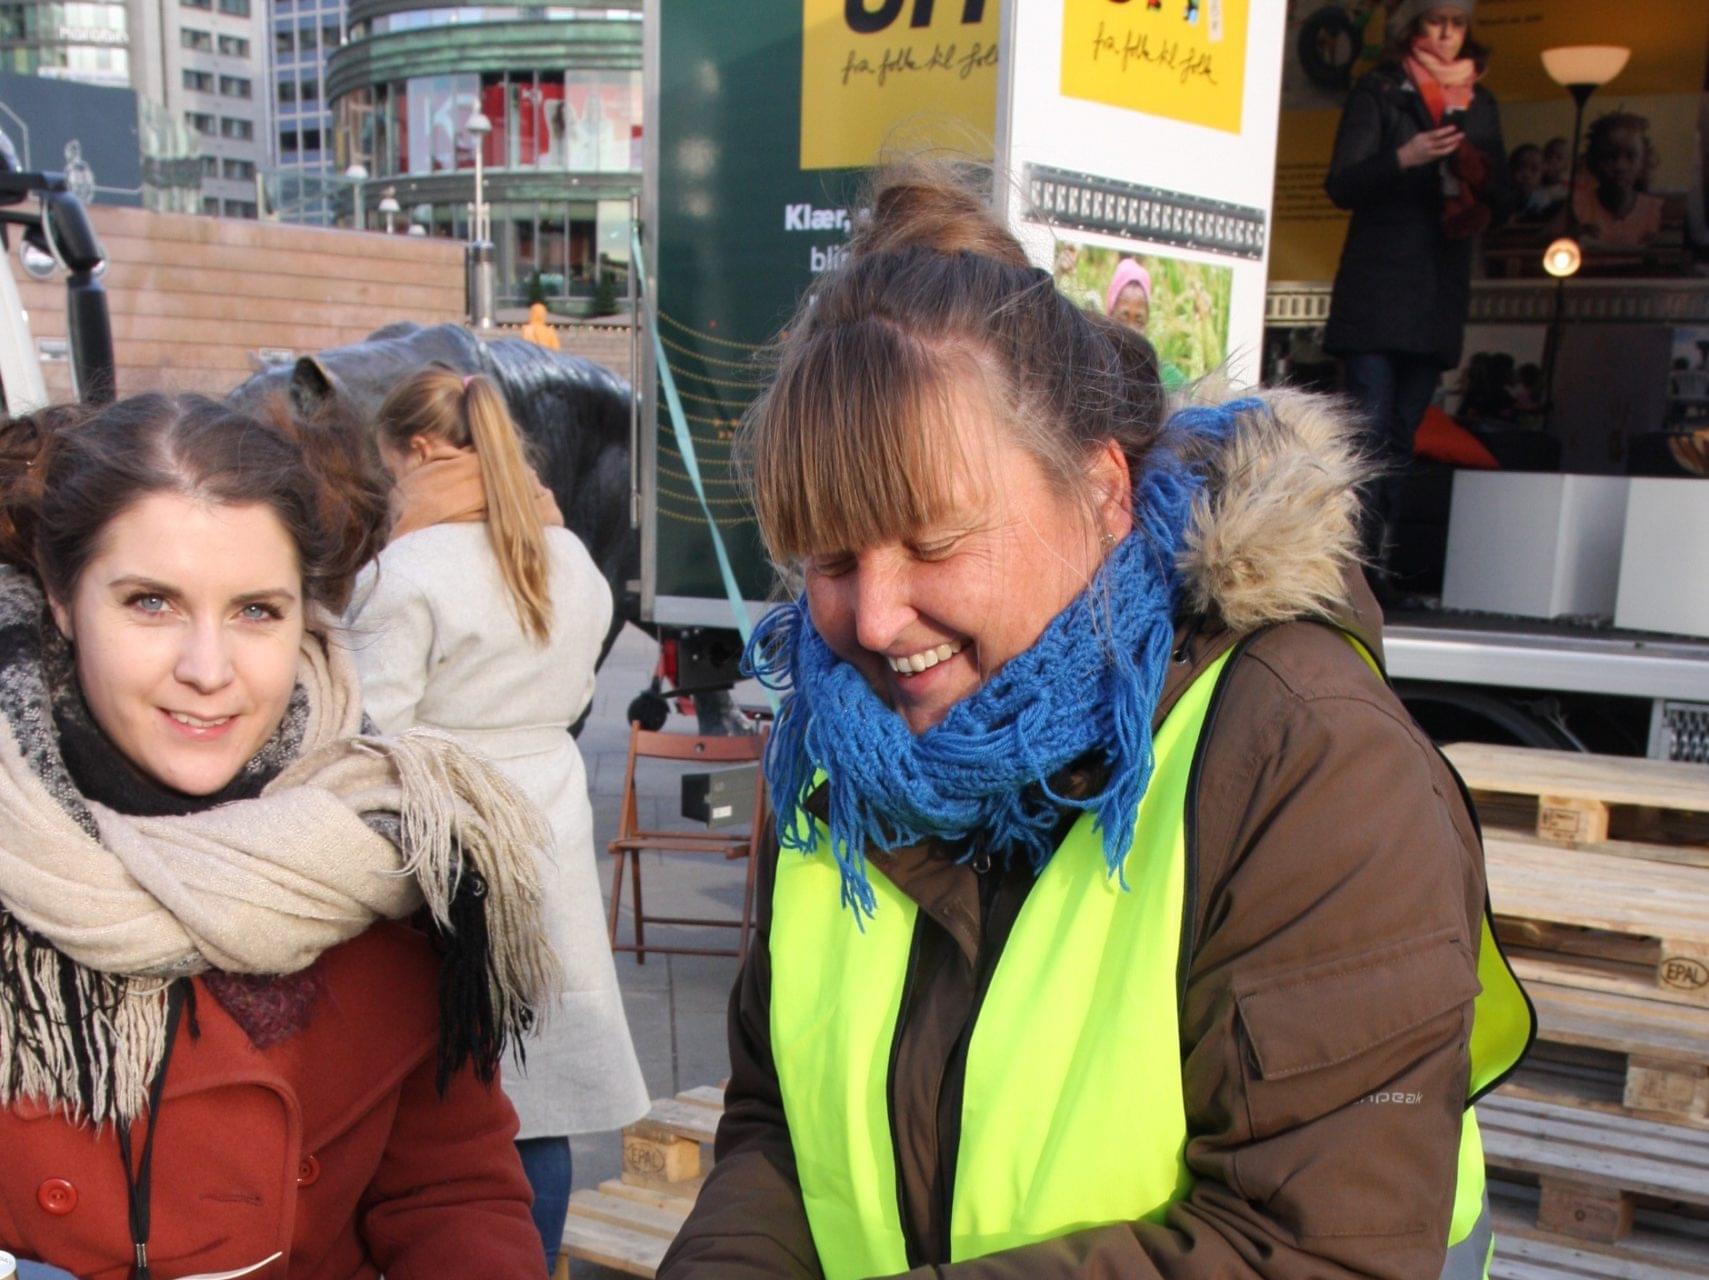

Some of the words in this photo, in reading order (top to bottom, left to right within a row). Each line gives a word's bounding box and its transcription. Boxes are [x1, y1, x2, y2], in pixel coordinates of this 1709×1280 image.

[842, 50, 875, 86] fra
[877, 48, 922, 87] folk
[924, 45, 956, 71] til
[958, 42, 998, 80] fol
[1093, 20, 1119, 61] fra
[1120, 29, 1155, 72] folk
[1178, 47, 1218, 85] folk
[785, 204, 851, 233] Klær,
[1667, 962, 1704, 986] EPAL
[631, 1146, 659, 1169] EPAL
